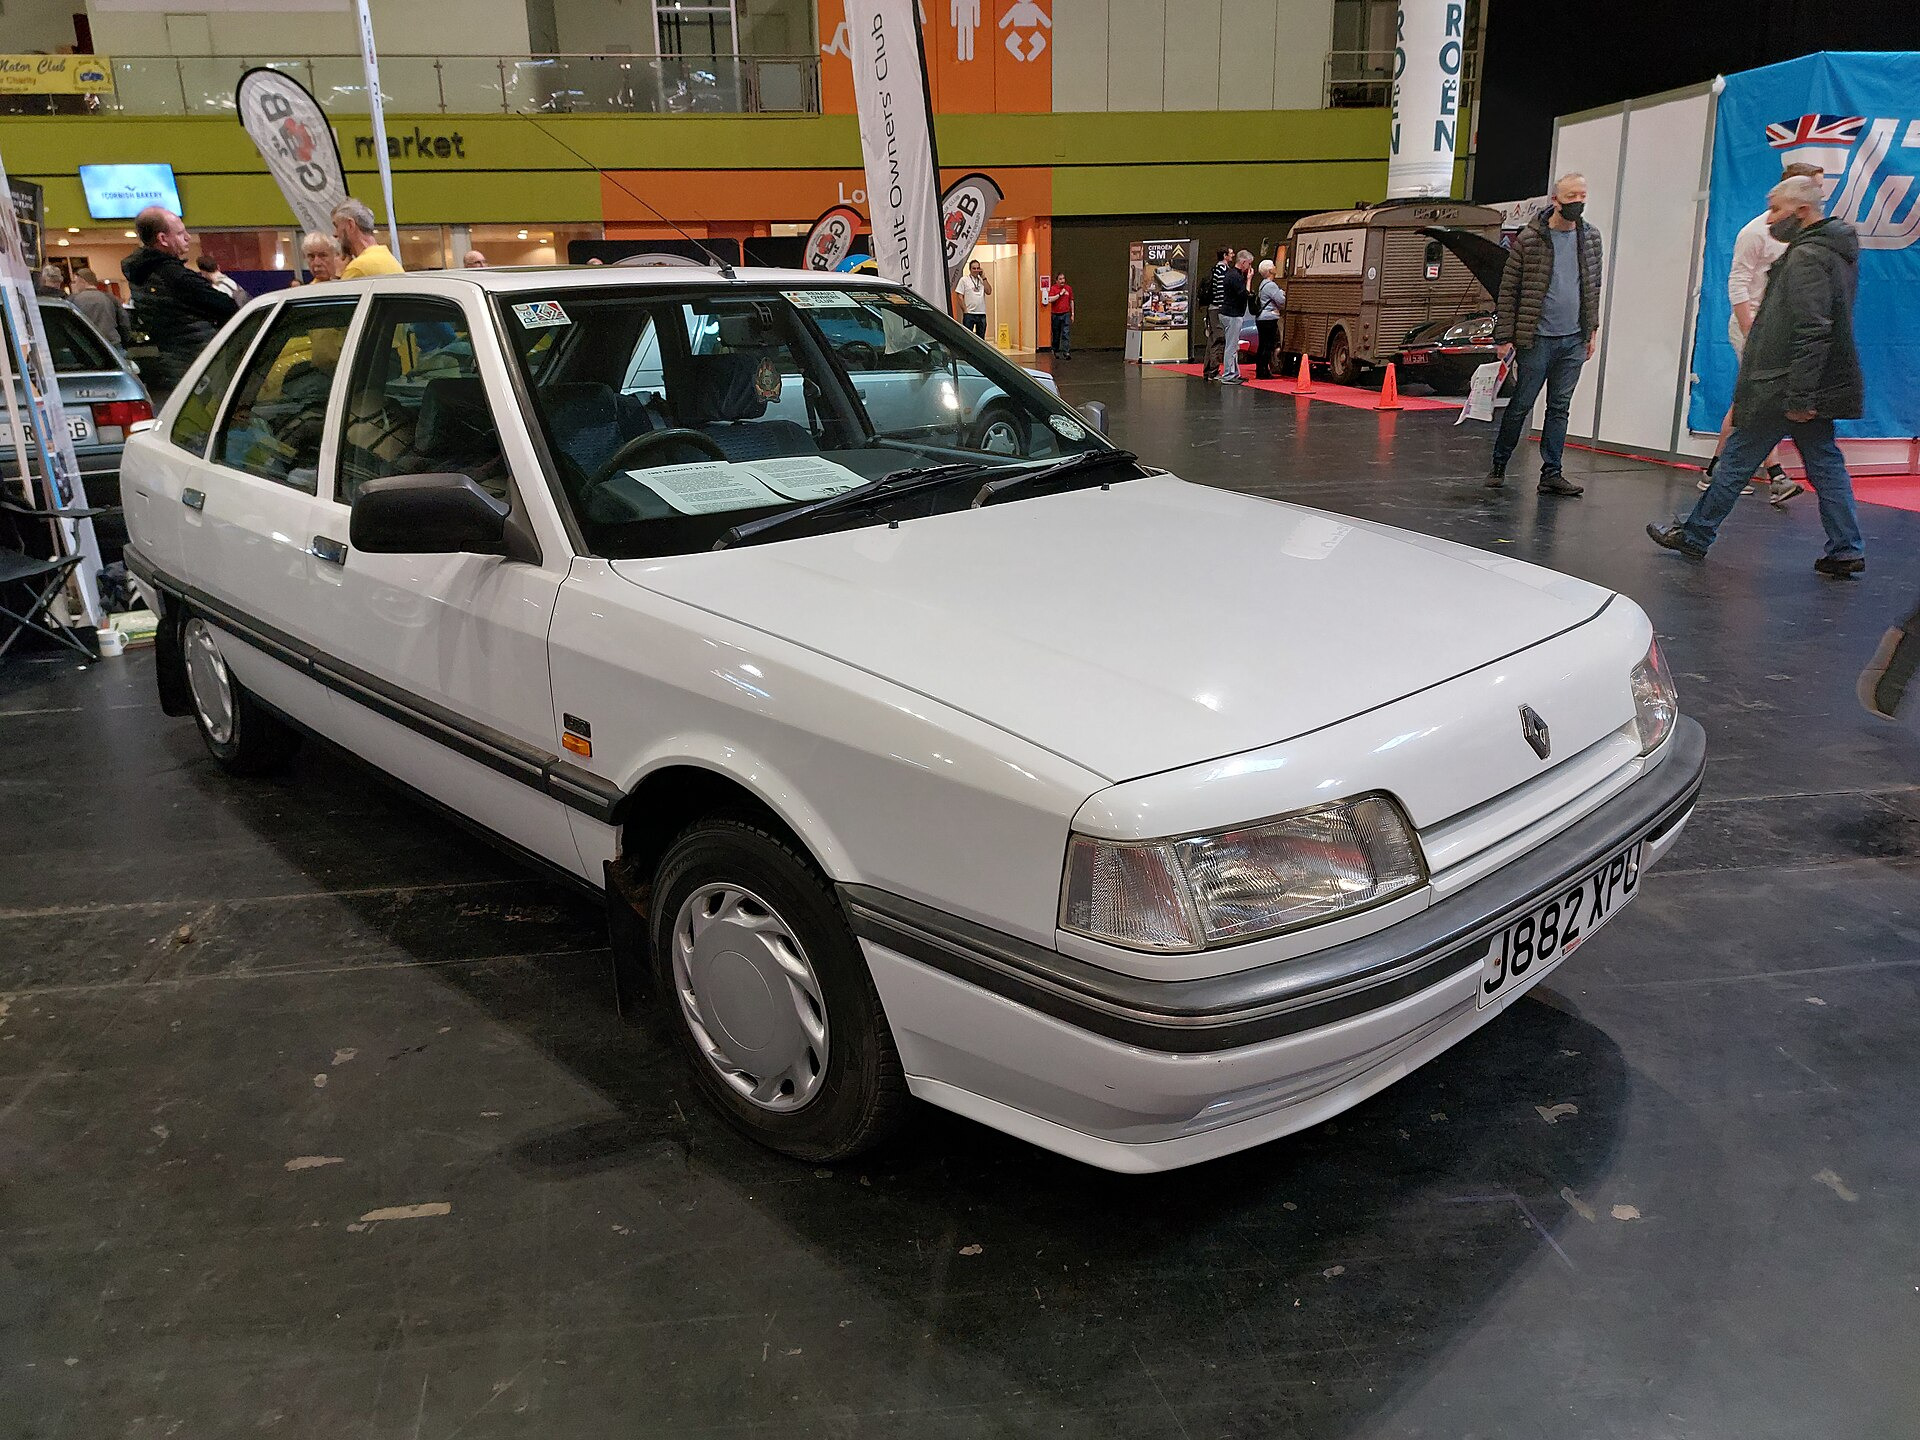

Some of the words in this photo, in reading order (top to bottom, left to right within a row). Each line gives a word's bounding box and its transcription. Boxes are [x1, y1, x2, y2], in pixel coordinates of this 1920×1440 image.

[871, 13, 888, 81] Club
[37, 58, 66, 74] Club
[355, 127, 465, 159] market
[879, 91, 903, 208] Owners'
[1148, 250, 1166, 260] SM
[1322, 237, 1353, 264] RENÉ
[1483, 886, 1584, 995] J882
[1586, 843, 1642, 929] XPU
